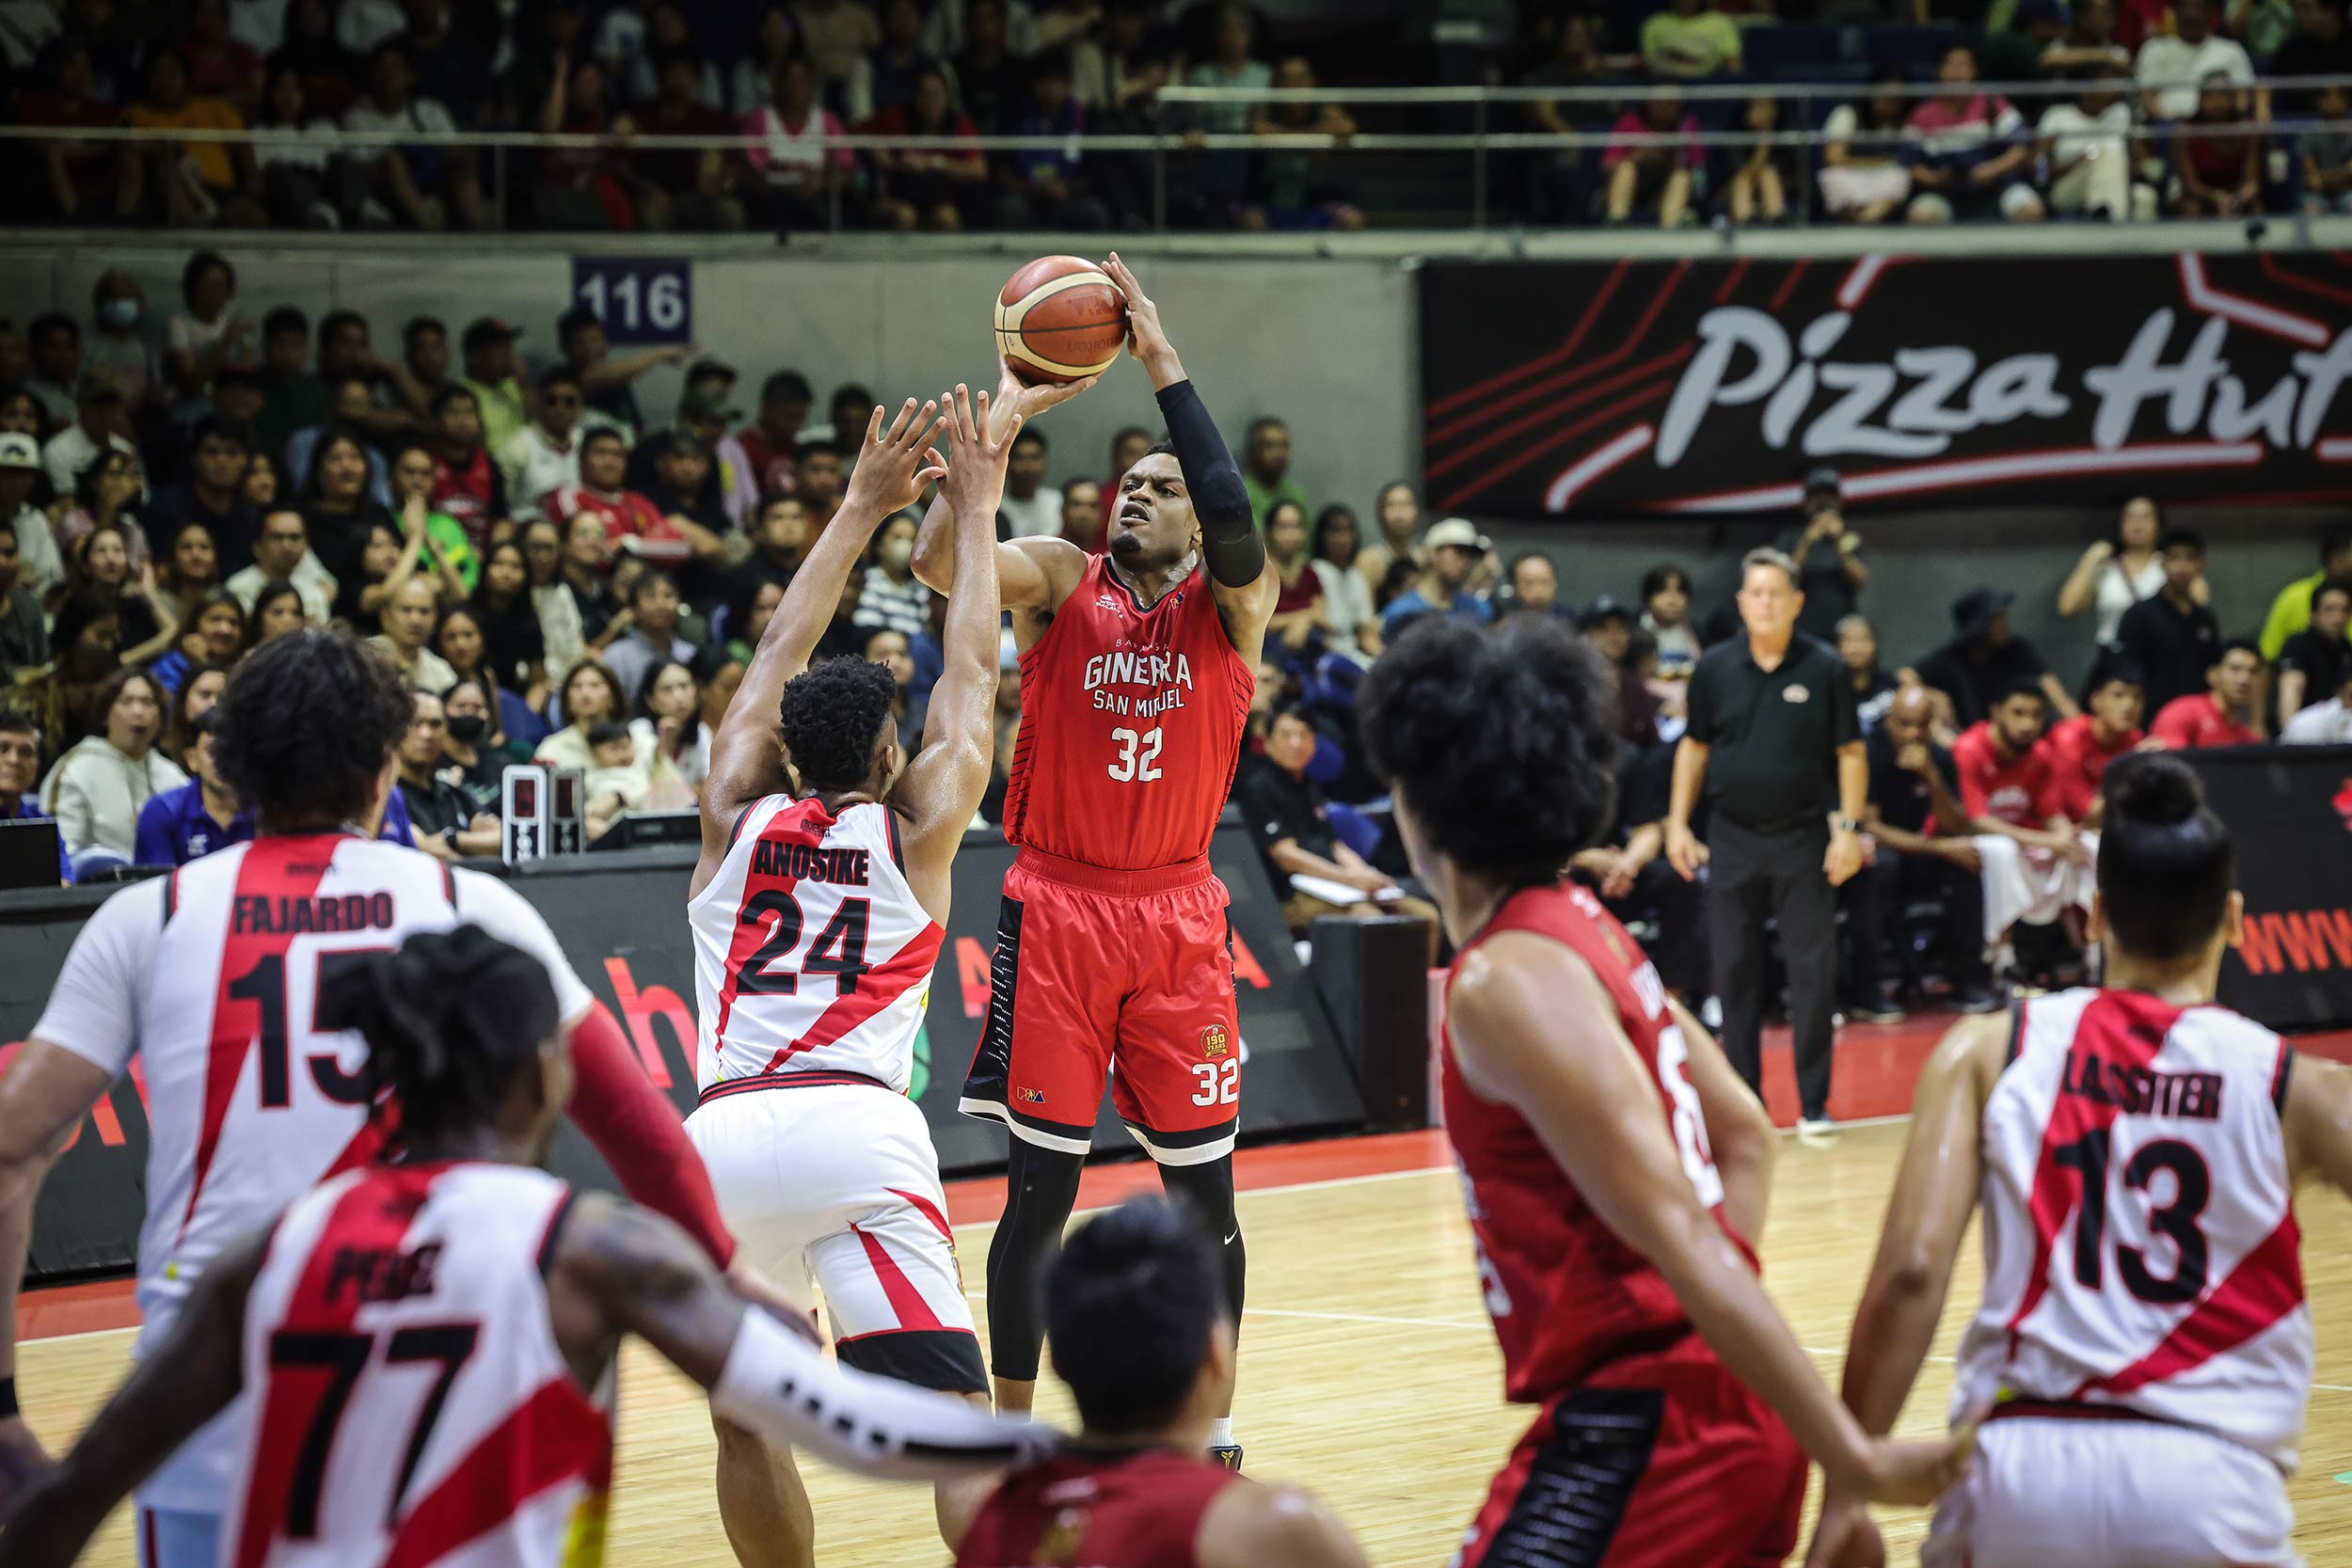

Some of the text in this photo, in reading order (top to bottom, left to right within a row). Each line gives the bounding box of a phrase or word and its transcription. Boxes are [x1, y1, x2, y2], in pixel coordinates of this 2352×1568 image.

[580, 271, 684, 329] 116
[1655, 305, 2352, 467] Pizza Hut
[1093, 689, 1129, 717] SAN
[1107, 726, 1163, 783] 32
[753, 840, 869, 887] ANOSIKE
[234, 892, 394, 933] FAJARDO
[736, 889, 873, 998] 24
[1206, 1033, 1226, 1046] 190
[1191, 1057, 1238, 1107] 32
[2054, 1129, 2210, 1305] 13
[269, 1323, 481, 1540] 77
